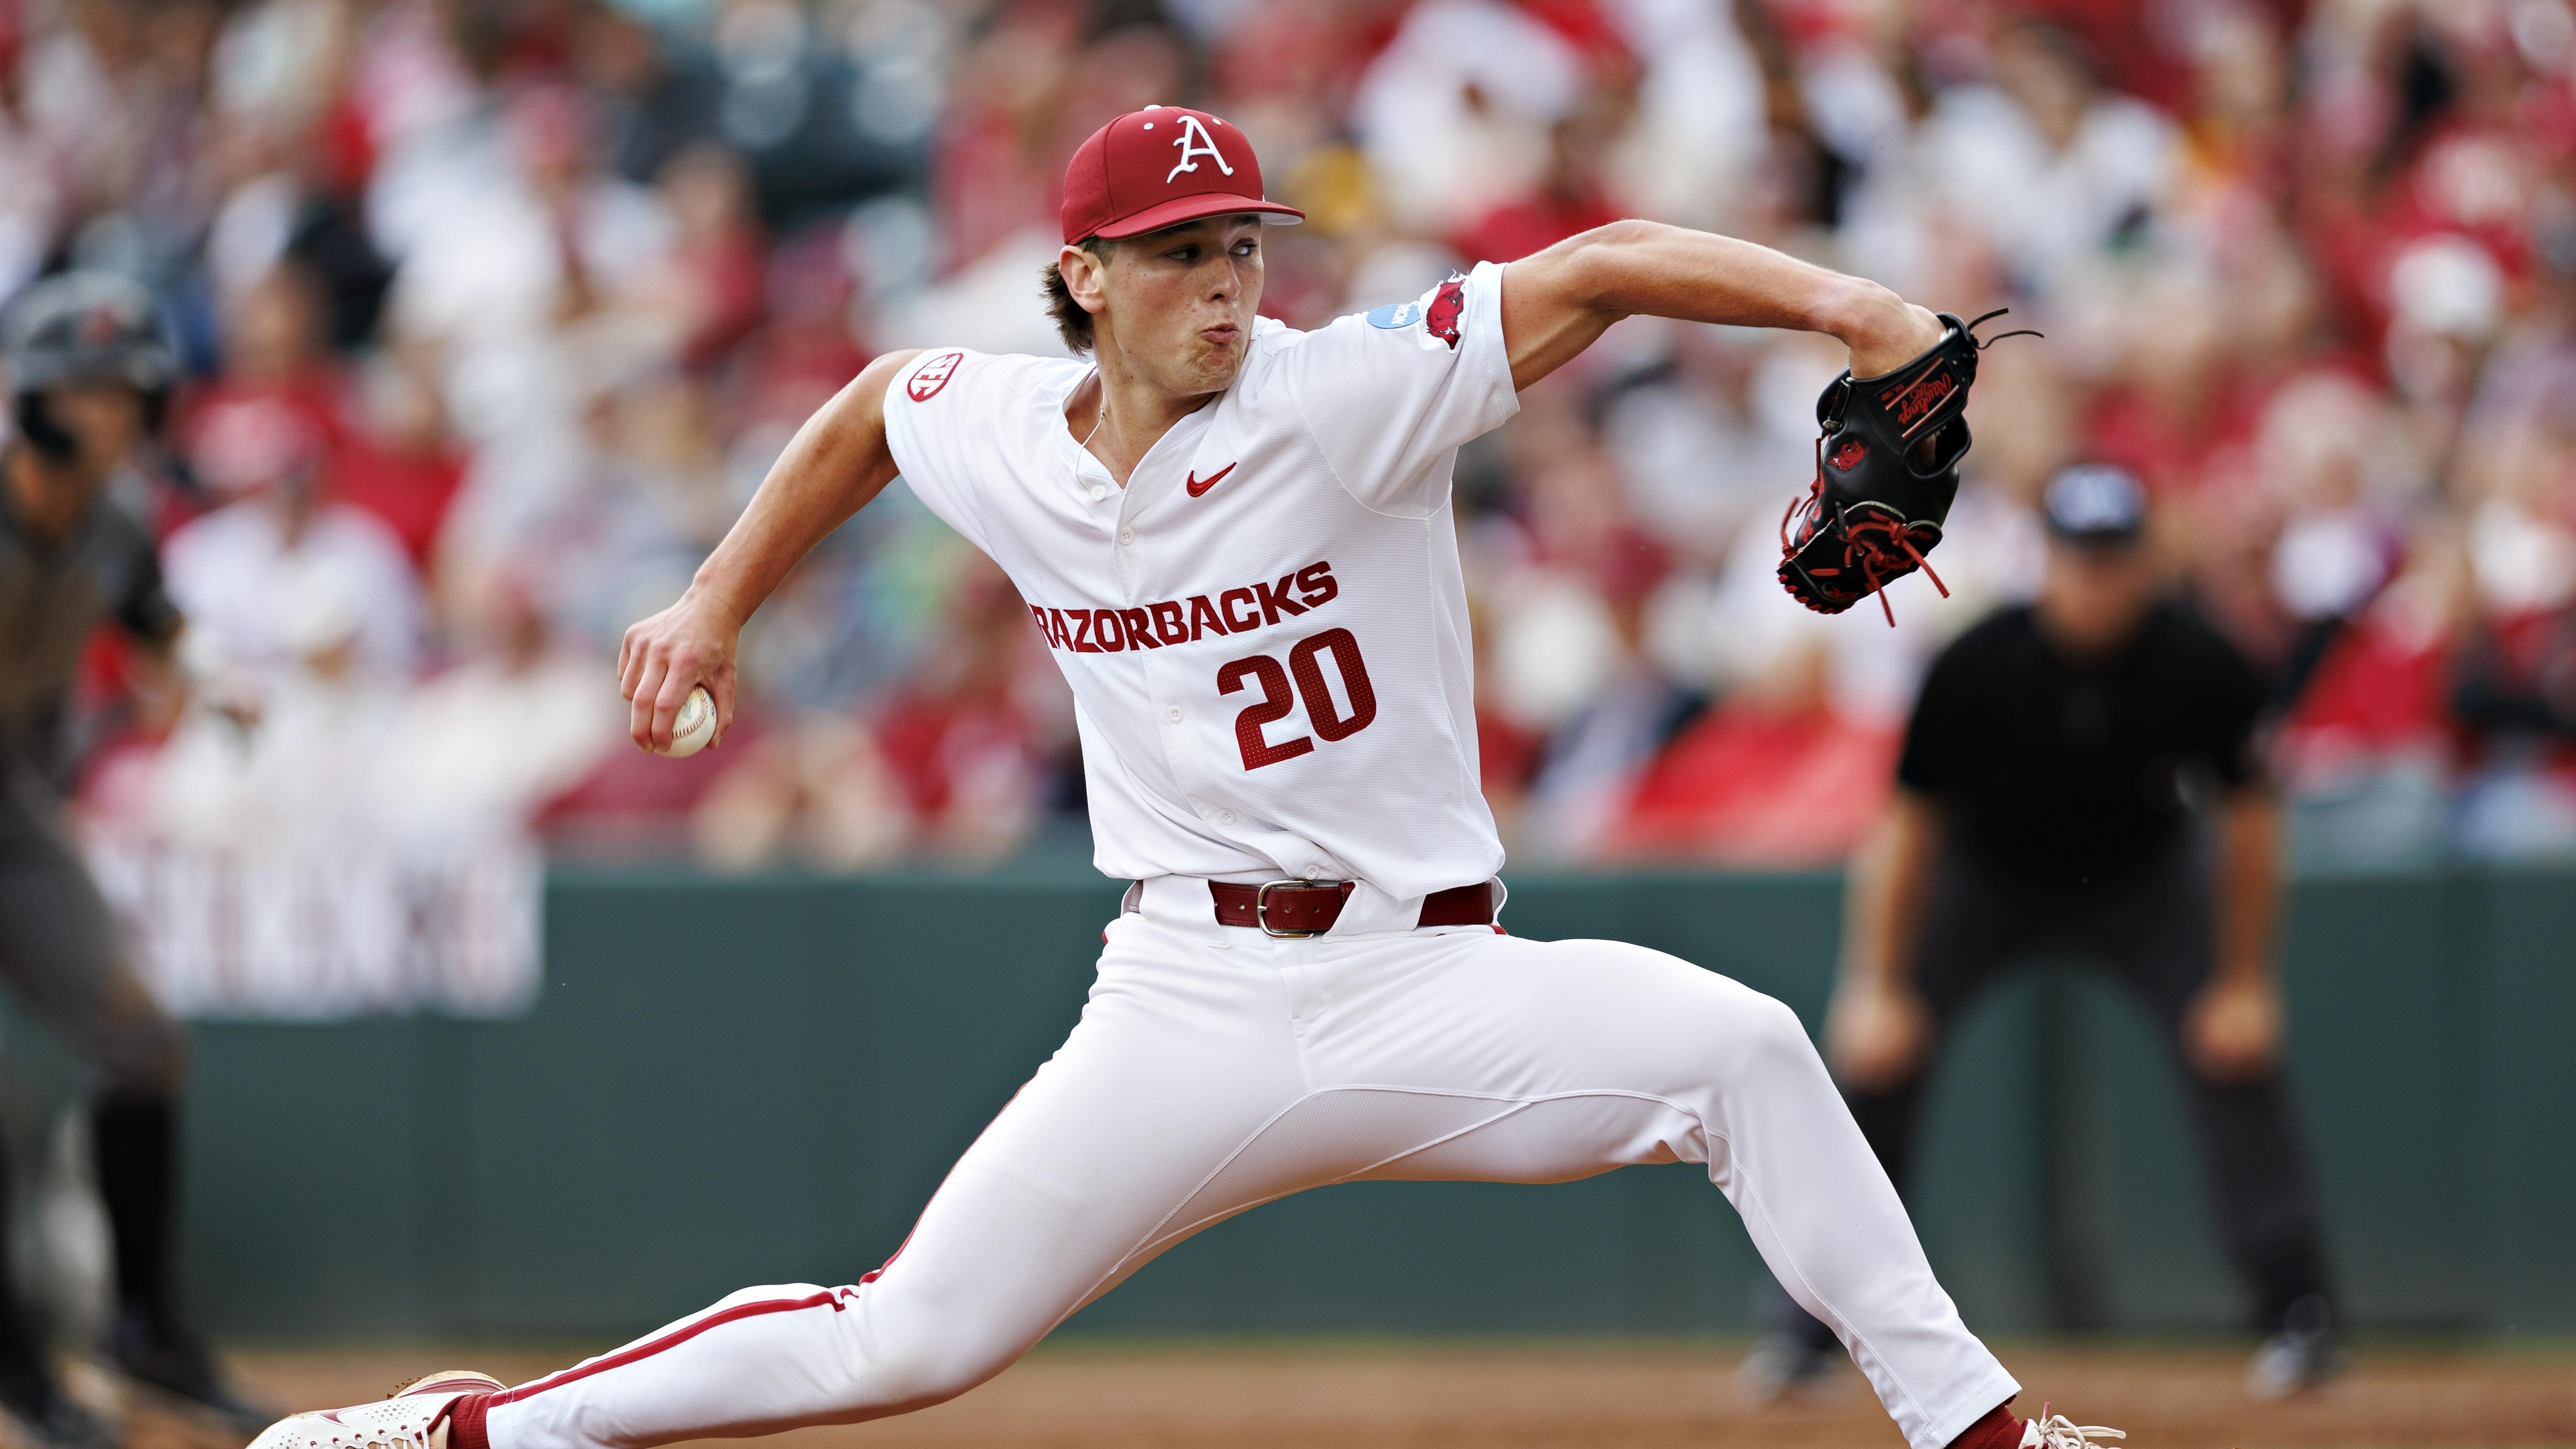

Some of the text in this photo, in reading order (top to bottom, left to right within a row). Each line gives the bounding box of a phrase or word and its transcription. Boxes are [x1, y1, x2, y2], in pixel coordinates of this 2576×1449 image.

[1167, 115, 1234, 183] A
[1391, 304, 1411, 325] NCAA
[910, 353, 961, 397] SEC
[1898, 373, 1951, 424] Rawlings
[1029, 561, 1338, 652] RAZORBACKS
[1217, 628, 1376, 771] 20
